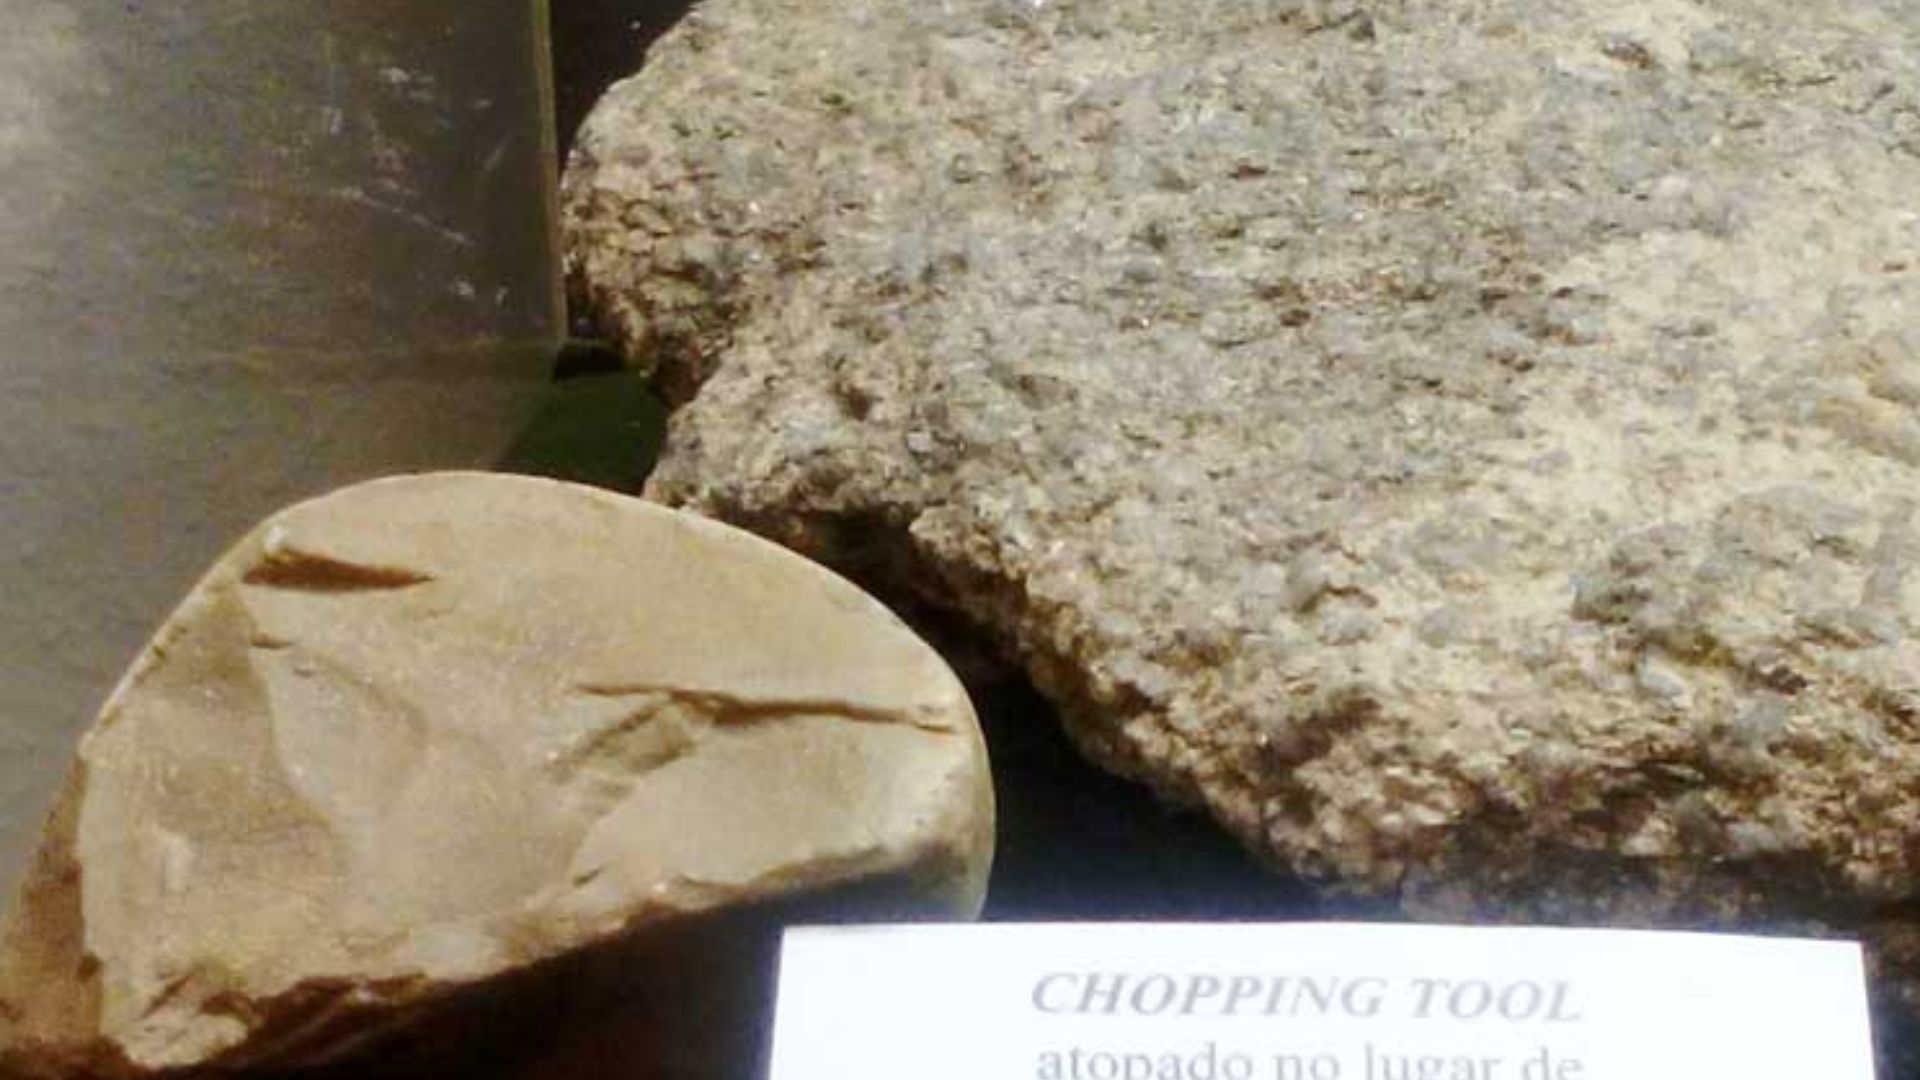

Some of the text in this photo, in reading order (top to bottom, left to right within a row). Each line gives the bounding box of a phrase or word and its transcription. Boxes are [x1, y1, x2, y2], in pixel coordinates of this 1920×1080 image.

[1032, 972, 1584, 1022] CHOPPING TOOL
[1036, 1042, 1584, 1080] atopado no lugar de
